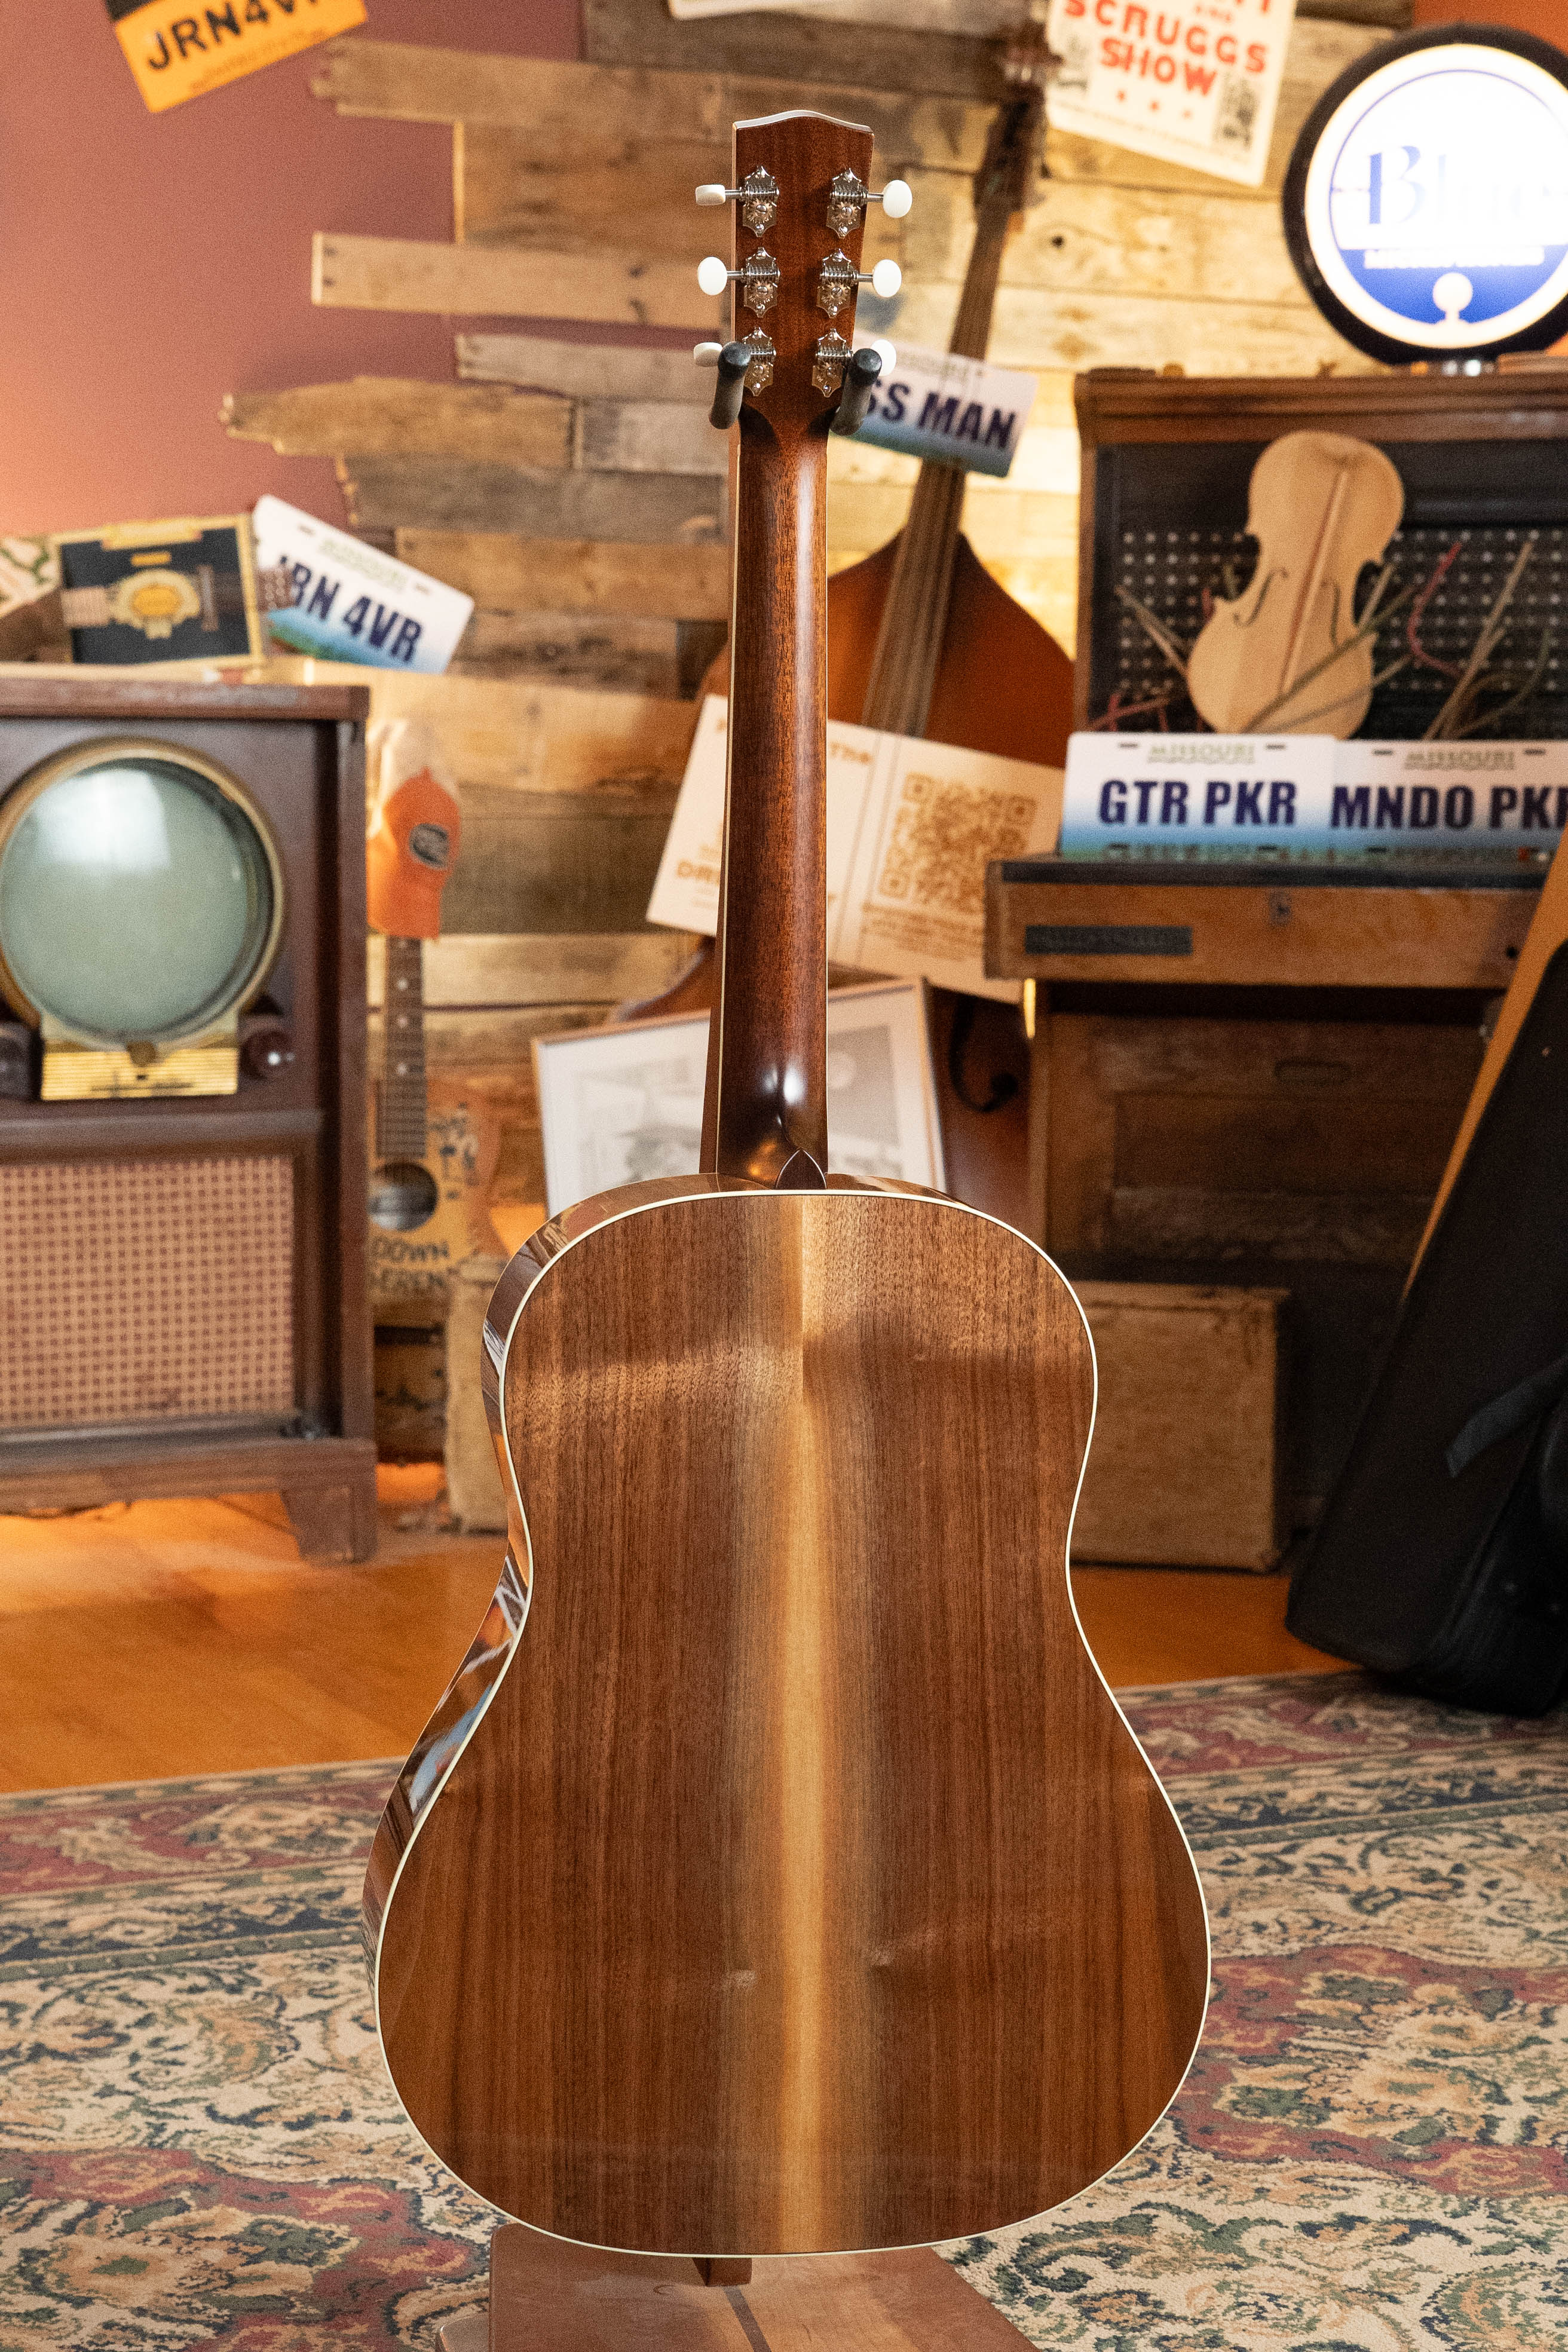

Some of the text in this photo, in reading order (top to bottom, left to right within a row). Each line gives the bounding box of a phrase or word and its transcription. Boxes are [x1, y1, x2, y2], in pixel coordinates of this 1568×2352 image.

[1101, 38, 1218, 96] SHOW
[917, 391, 1016, 450] MAN
[342, 595, 422, 663] 4VR
[1098, 779, 1298, 826] GTR PKR
[1331, 785, 1474, 829] MNDO
